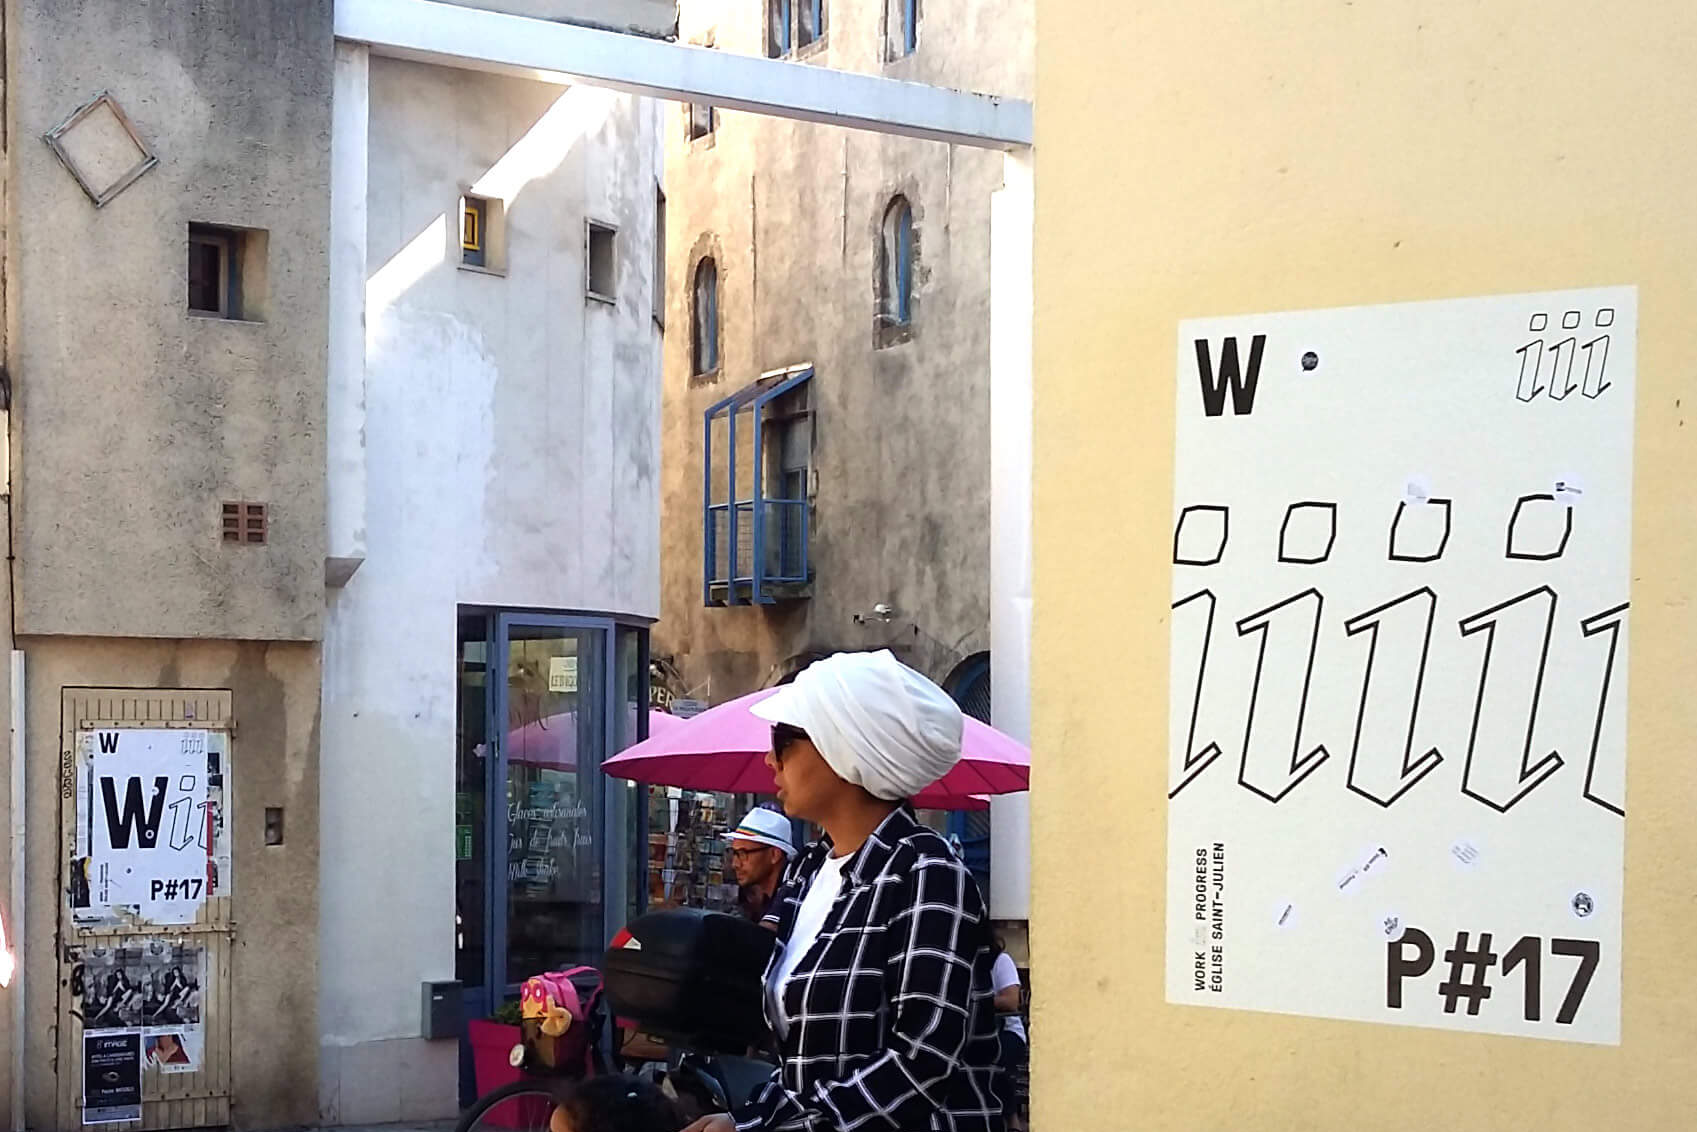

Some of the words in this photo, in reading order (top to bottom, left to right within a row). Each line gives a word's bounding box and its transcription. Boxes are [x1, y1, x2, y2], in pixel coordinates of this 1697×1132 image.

[1194, 334, 1267, 417] W
[99, 732, 119, 754] W
[151, 878, 203, 901] P#17
[1195, 848, 1207, 921] PROGRESS
[1212, 842, 1225, 940] SAINT-JULIEN
[1195, 951, 1206, 991] WORK
[1208, 945, 1223, 993] ÉGLISE
[1386, 927, 1601, 1025] P#17
